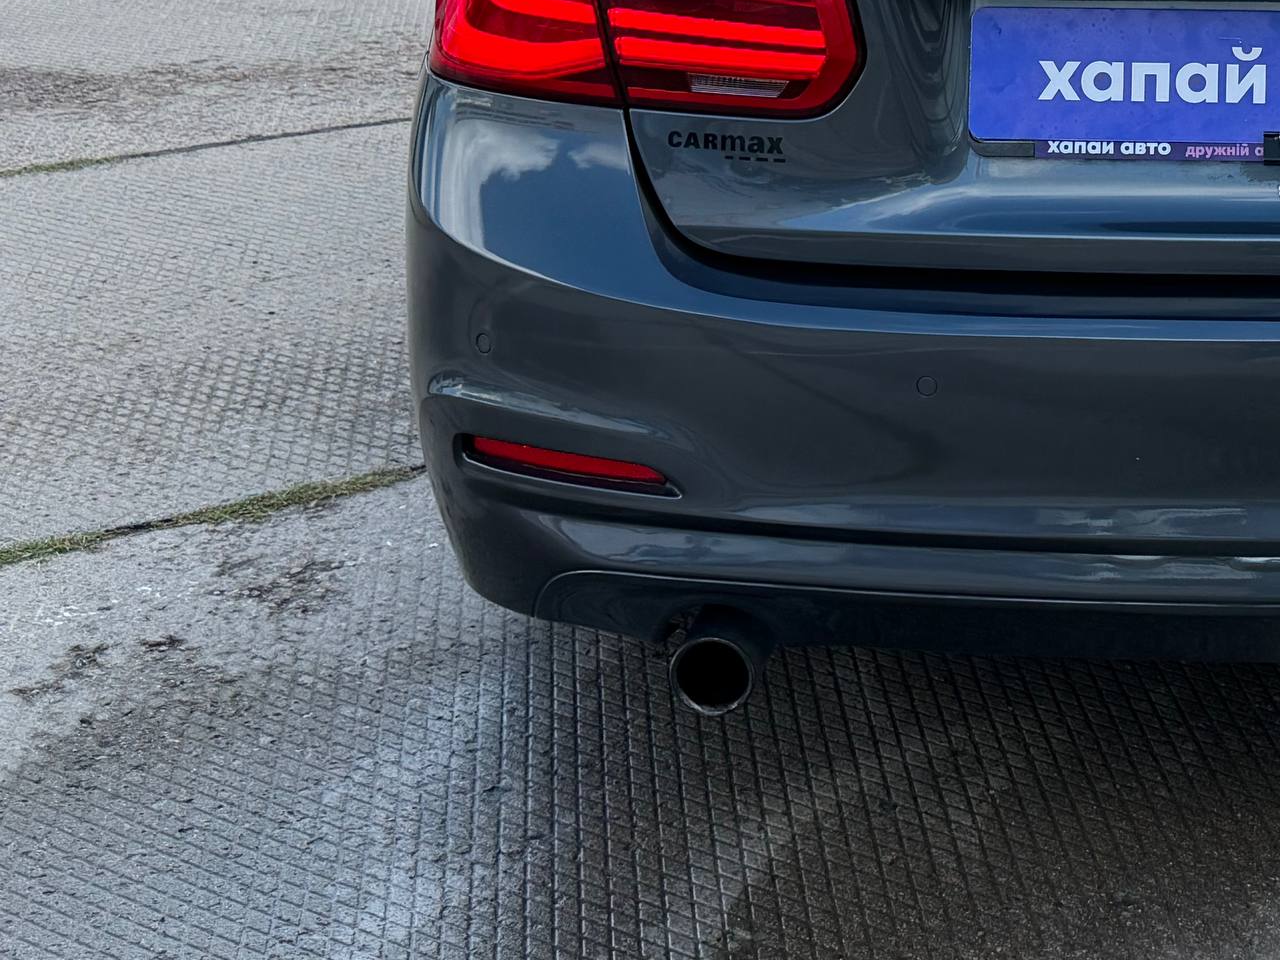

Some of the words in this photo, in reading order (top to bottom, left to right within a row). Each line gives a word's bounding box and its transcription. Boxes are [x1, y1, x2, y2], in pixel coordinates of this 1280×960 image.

[1038, 46, 1267, 104] хапай
[1120, 142, 1171, 155] авто
[1185, 144, 1250, 158] дружній
